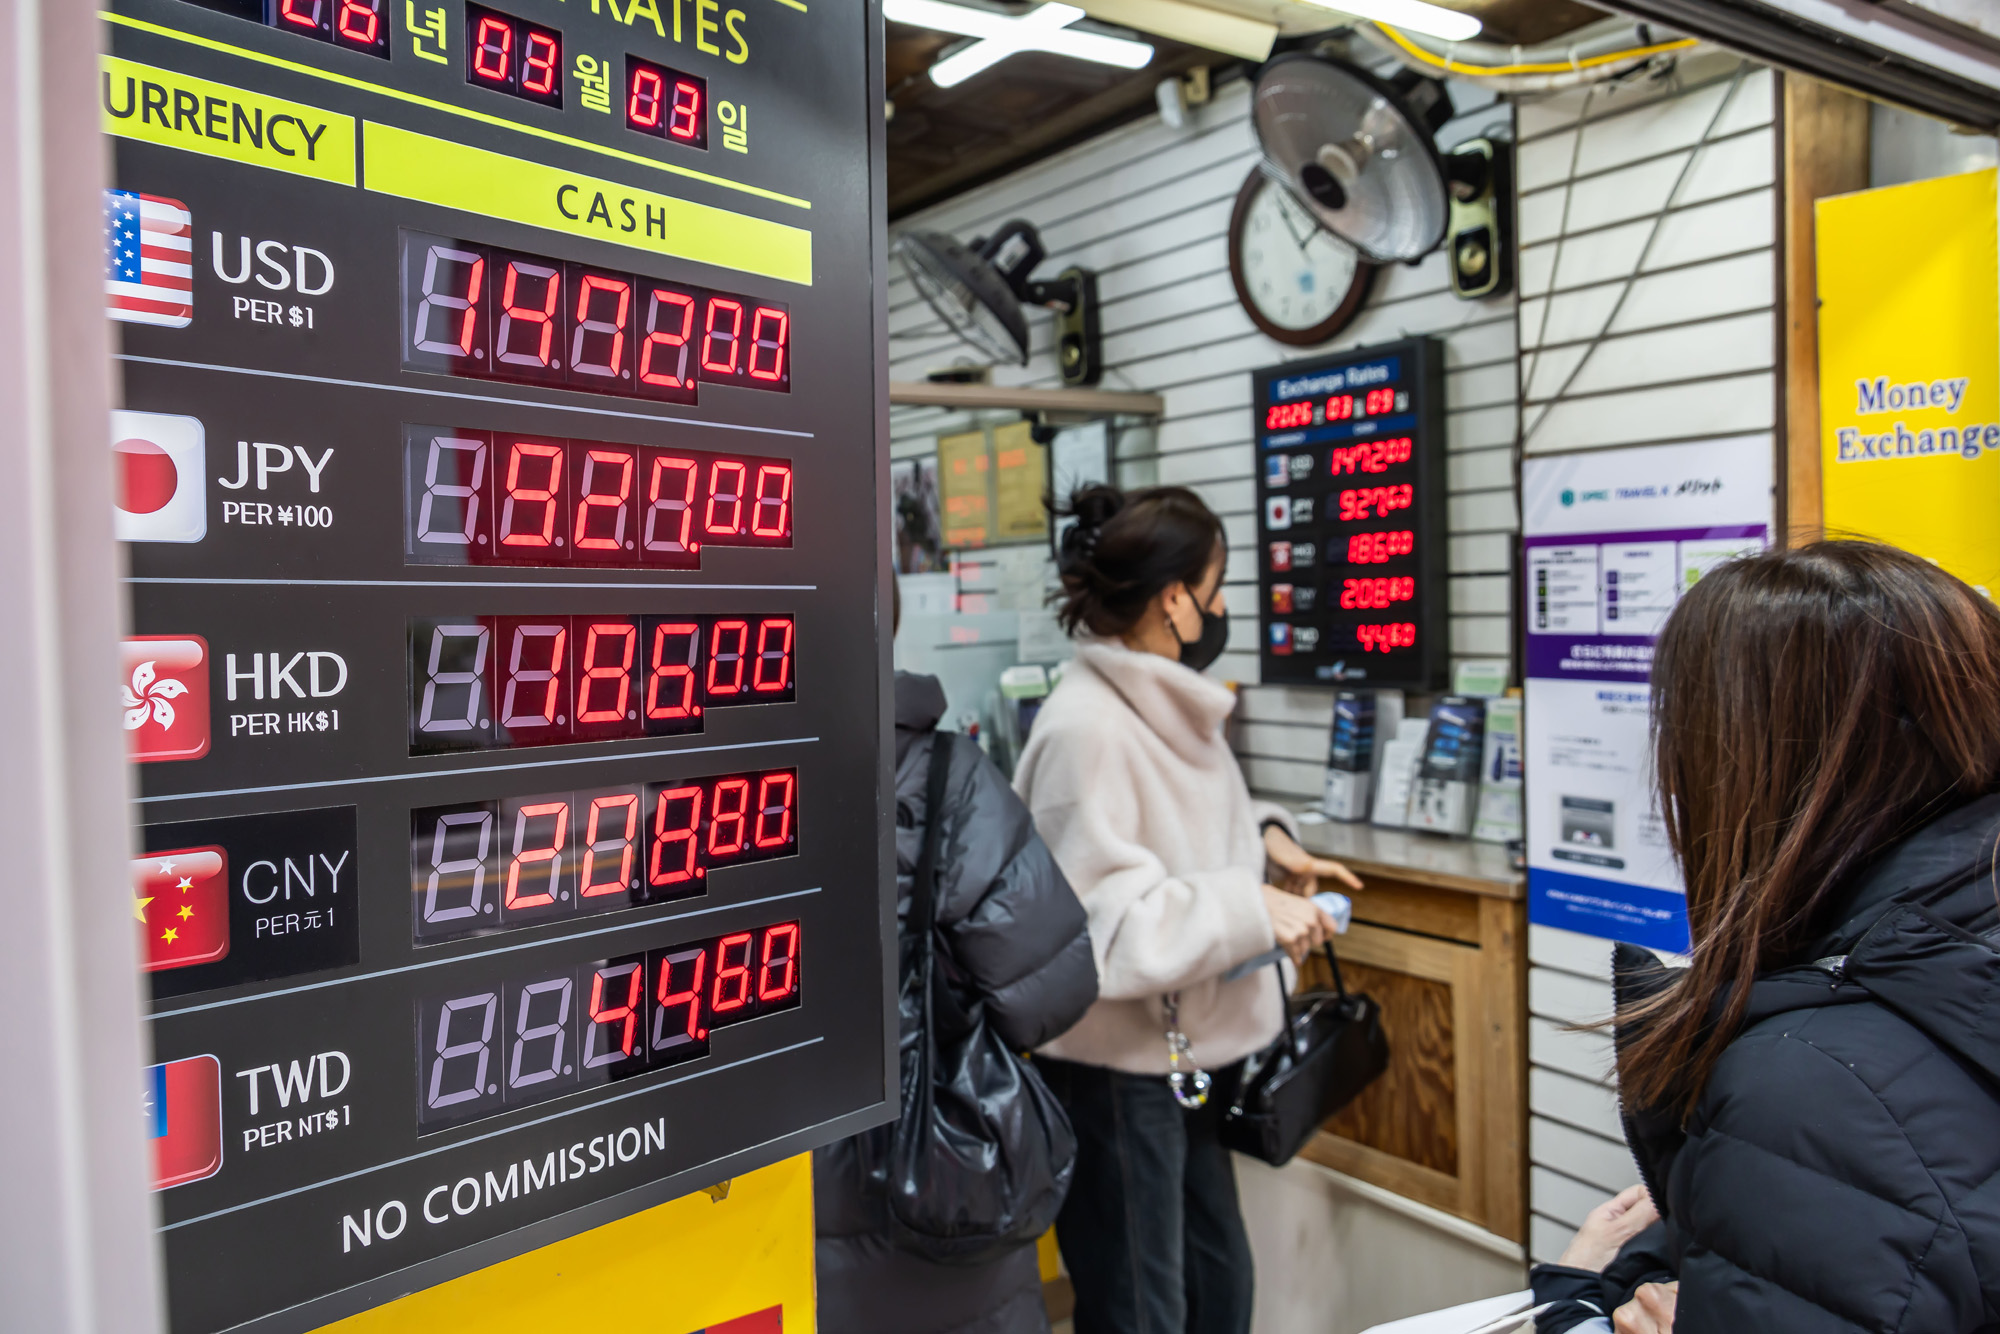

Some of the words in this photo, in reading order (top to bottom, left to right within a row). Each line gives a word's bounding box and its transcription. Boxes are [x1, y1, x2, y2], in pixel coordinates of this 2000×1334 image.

[474, 17, 556, 94] 03
[573, 54, 611, 114] 월
[629, 69, 700, 138] 03
[102, 71, 327, 161] URRENCY
[717, 100, 748, 154] 일
[556, 184, 668, 241] CASH
[211, 230, 335, 296] USD
[232, 296, 283, 325] PER
[288, 305, 314, 329] $1
[1277, 373, 1345, 399] Exchange
[1346, 365, 1389, 386] Rates
[1857, 379, 1968, 412] Money
[218, 441, 335, 493] JPY
[1836, 424, 2000, 461] Exchange
[222, 501, 274, 526] PER
[277, 504, 333, 528] ¥100
[226, 651, 348, 701] HKD
[230, 712, 281, 737] PER
[288, 709, 339, 733] HK$1
[242, 850, 349, 904] CNY
[236, 1050, 351, 1116] TWD
[242, 1119, 293, 1152] PER
[342, 1200, 407, 1254] NO
[423, 1117, 666, 1224] COMMISSION
